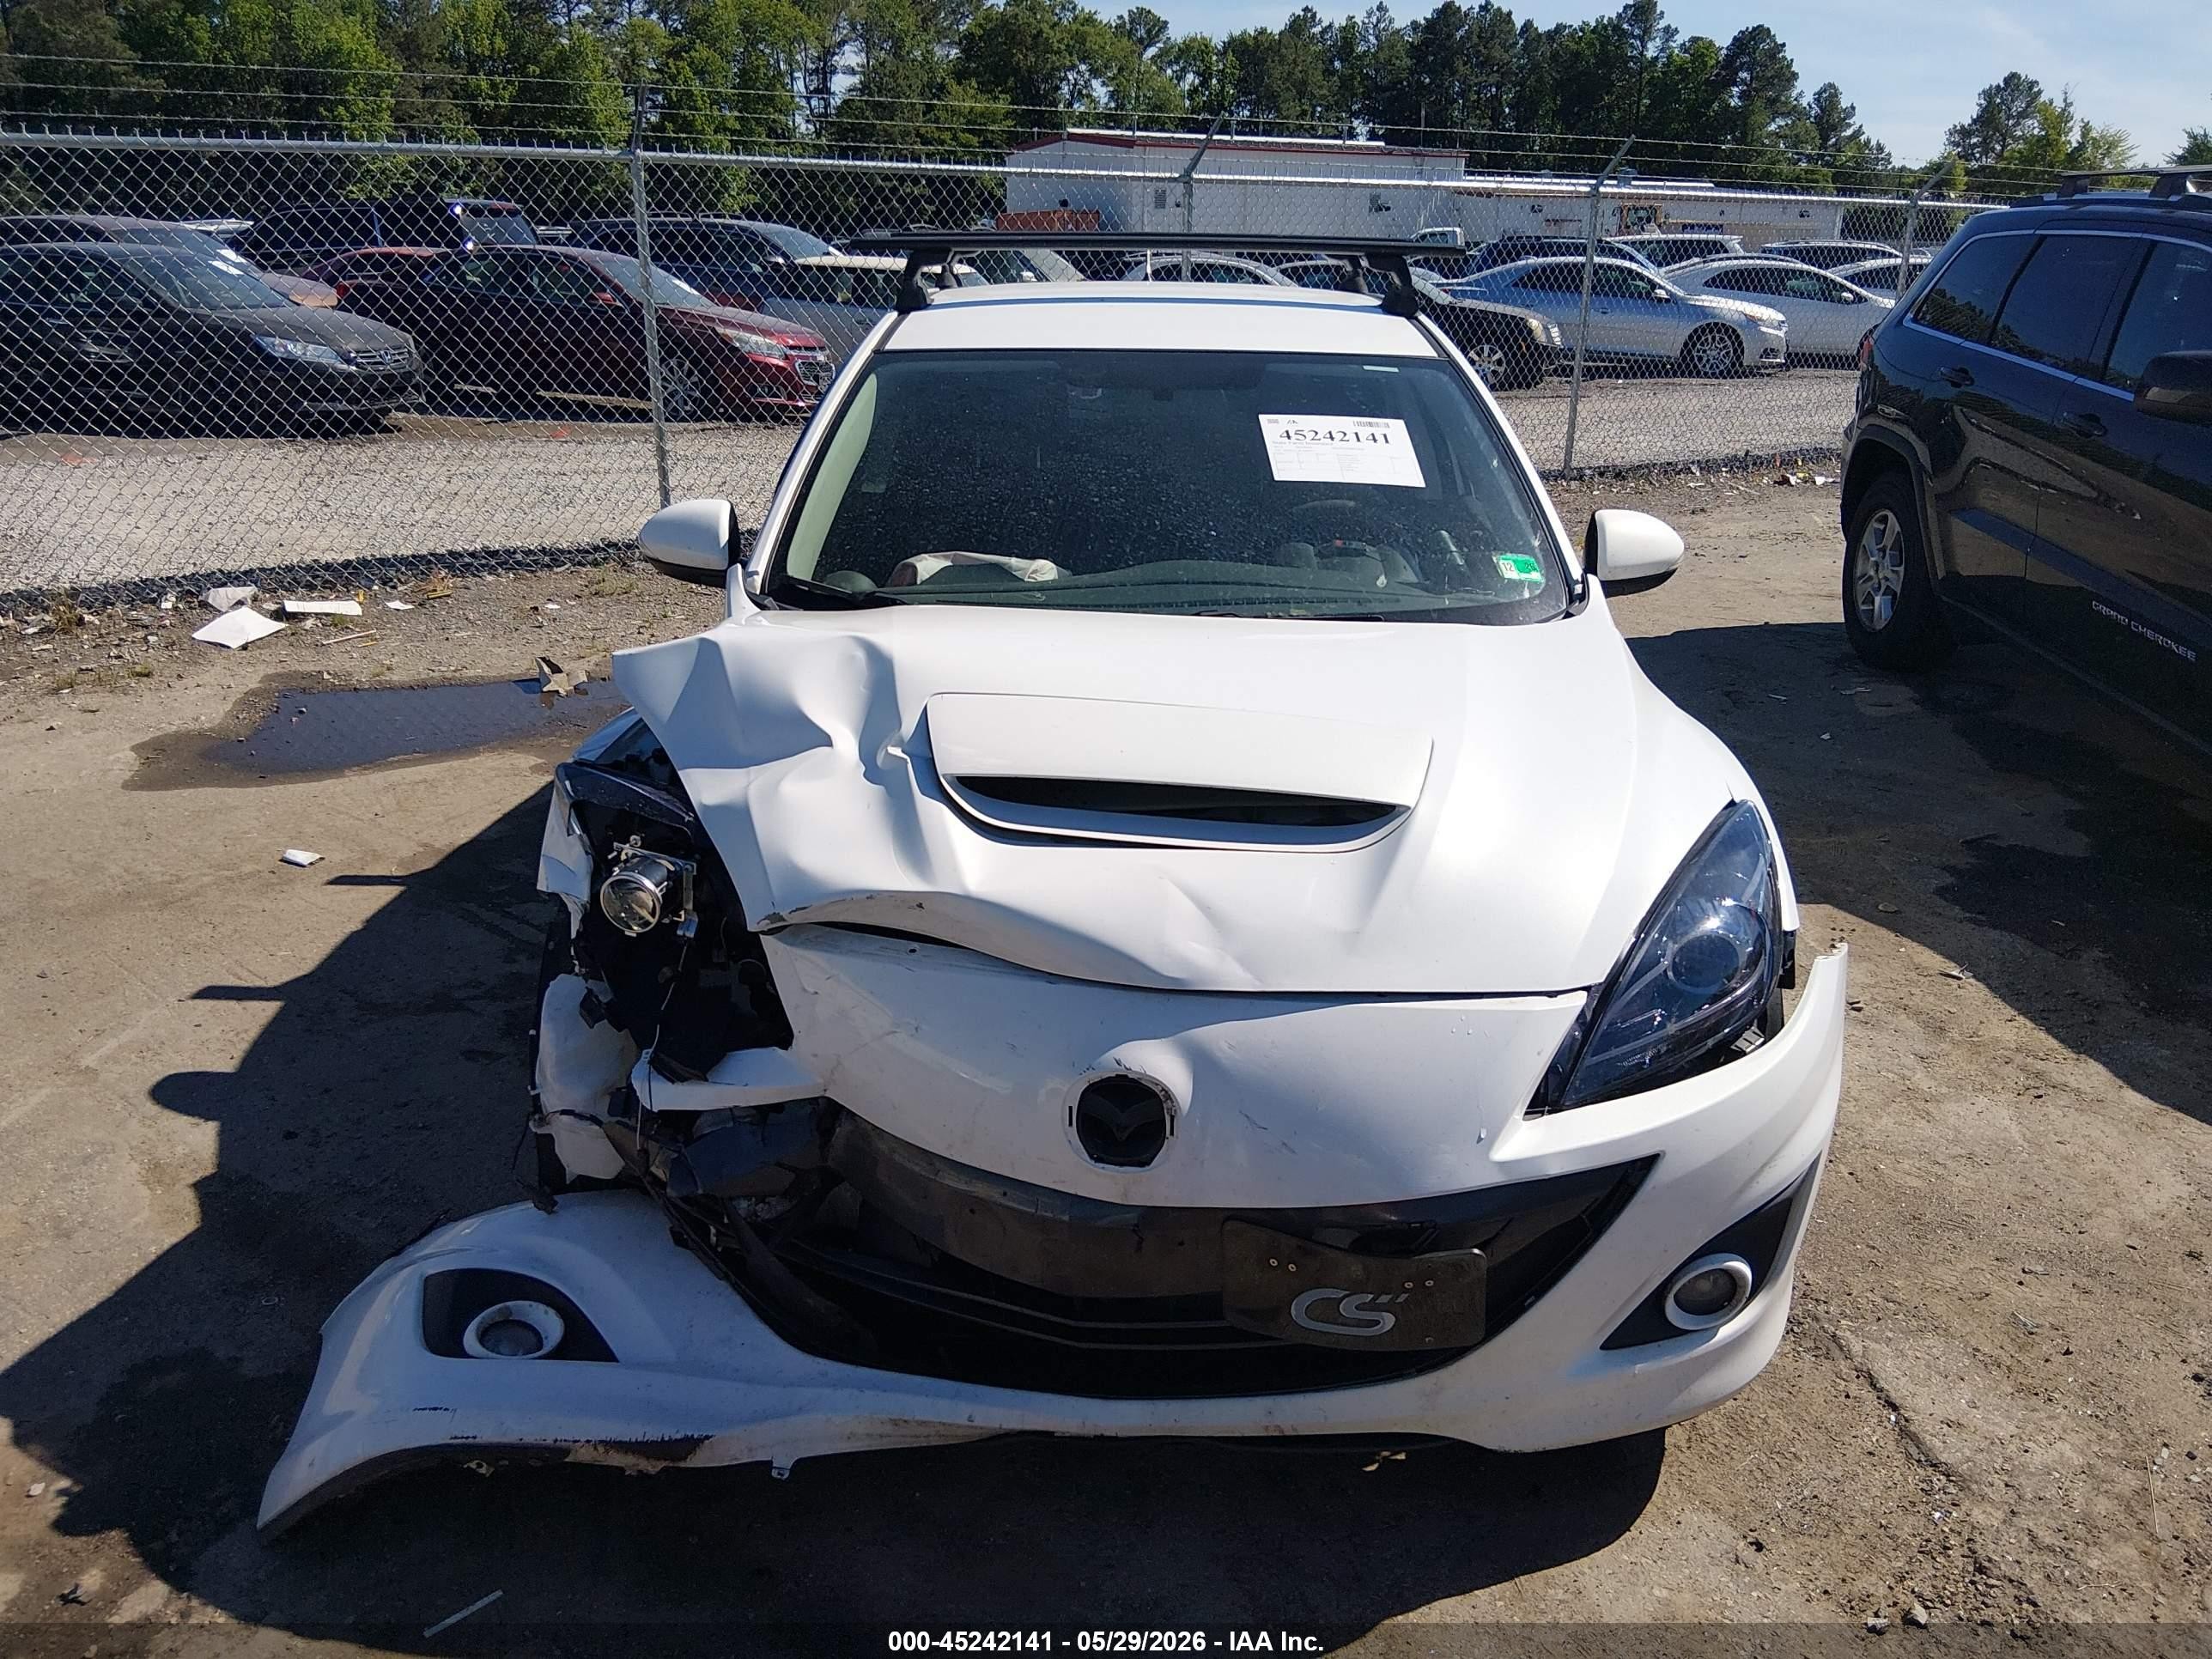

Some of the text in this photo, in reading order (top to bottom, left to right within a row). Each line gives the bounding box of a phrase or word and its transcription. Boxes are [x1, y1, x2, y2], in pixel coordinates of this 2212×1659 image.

[1279, 428, 1391, 445] 45242141
[1502, 562, 1515, 572] 12
[2092, 600, 2197, 662] GRAND CHEROKEE
